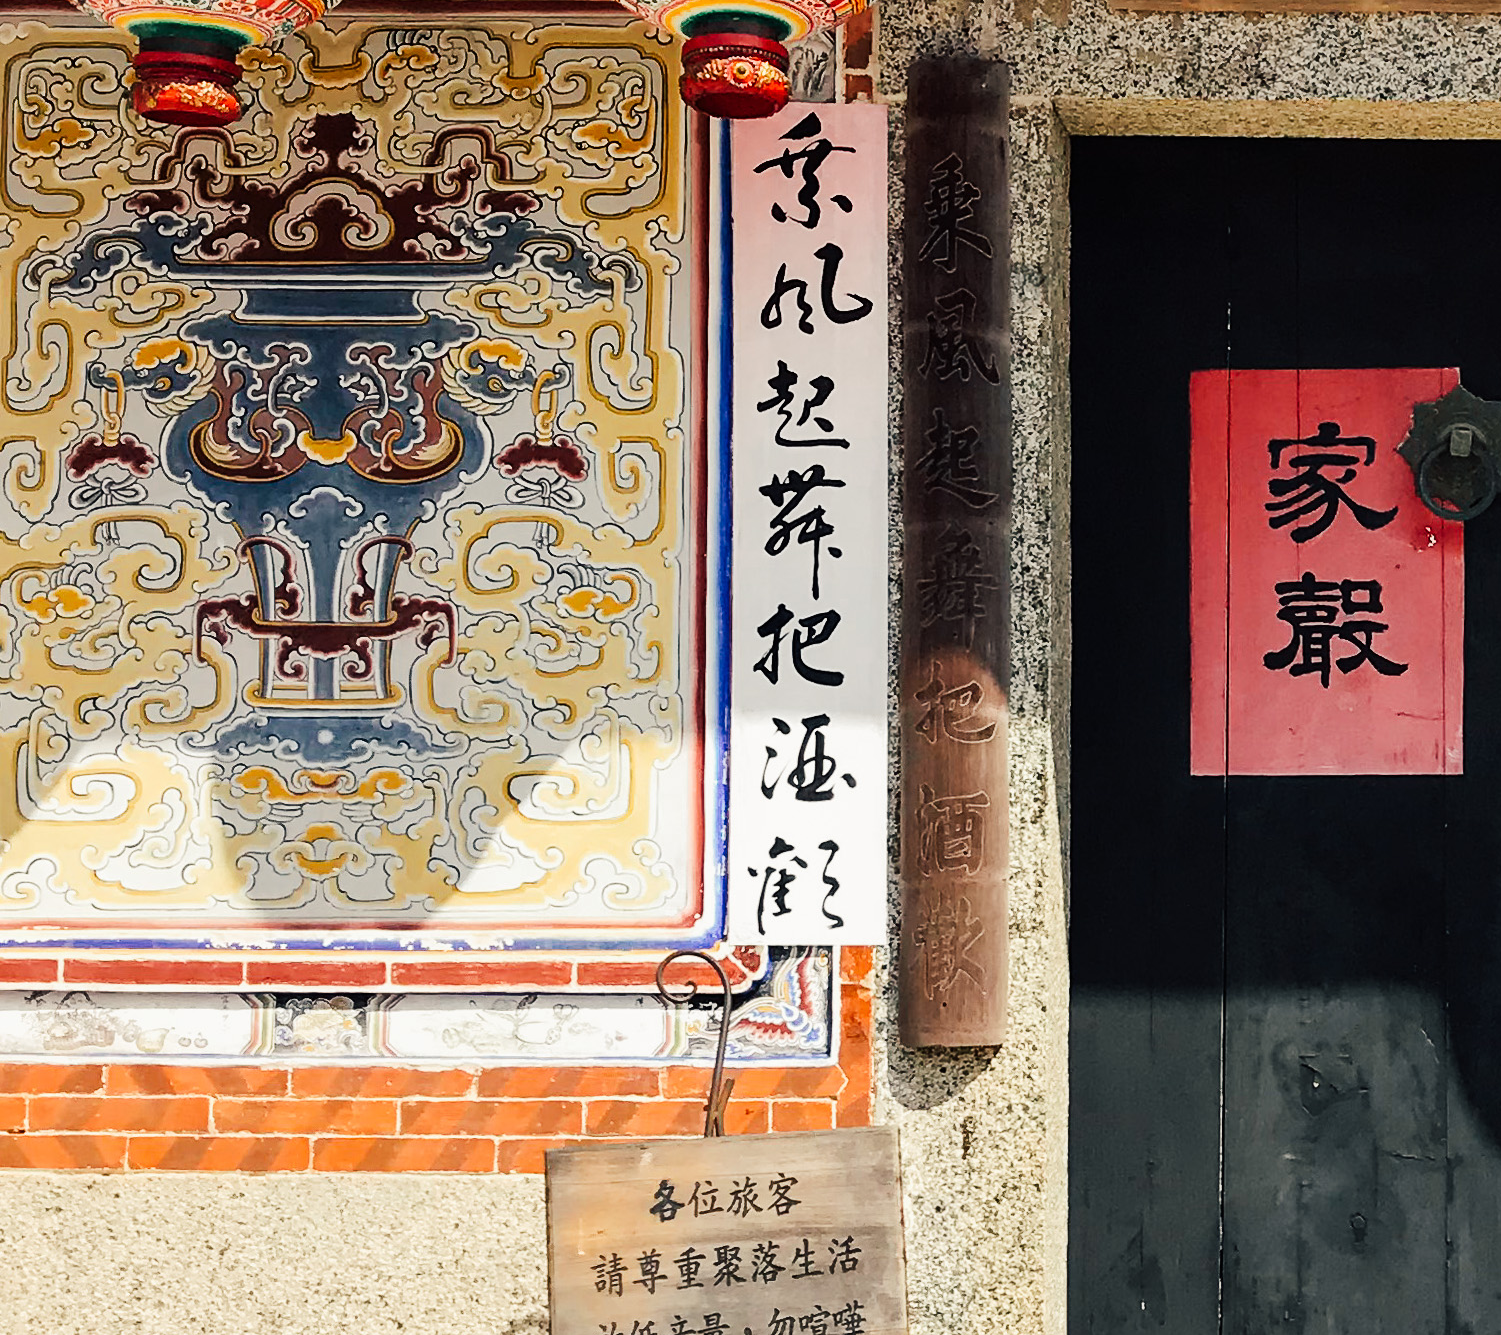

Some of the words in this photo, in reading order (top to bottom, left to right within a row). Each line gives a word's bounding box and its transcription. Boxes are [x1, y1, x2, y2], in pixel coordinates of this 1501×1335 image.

[648, 1172, 803, 1223] 各位旅客
[590, 1235, 863, 1298] 請尊重聚落生活
